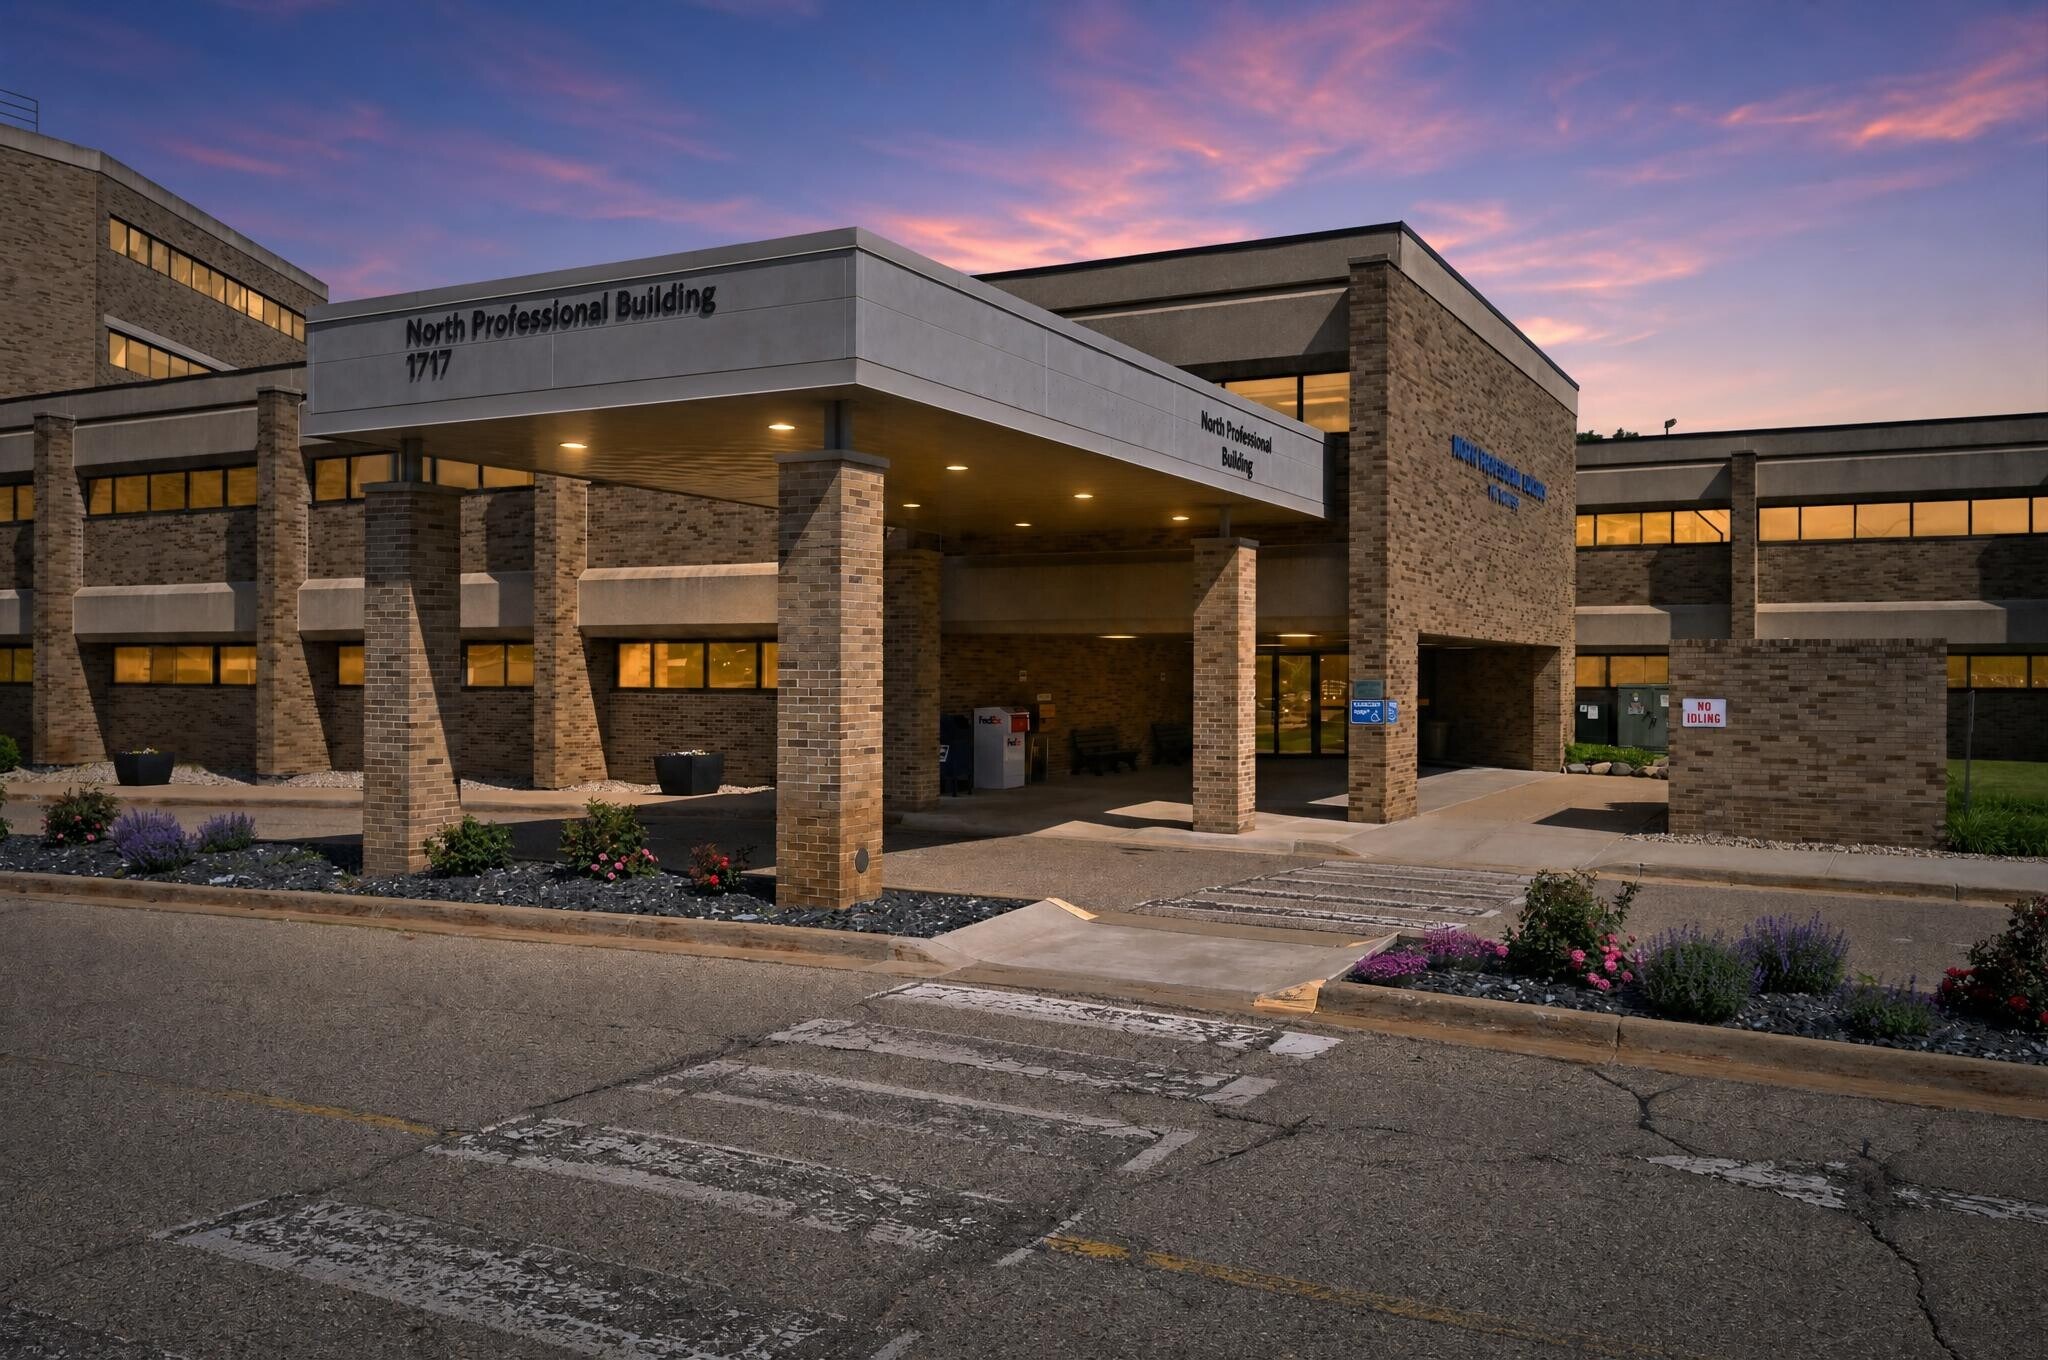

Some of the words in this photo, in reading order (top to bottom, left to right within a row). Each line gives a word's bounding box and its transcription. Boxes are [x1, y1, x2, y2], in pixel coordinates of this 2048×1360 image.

[406, 312, 465, 347] North
[472, 292, 608, 340] Professional
[616, 282, 716, 319] Building
[406, 350, 452, 382] 1717
[1201, 410, 1225, 437] North
[1226, 420, 1272, 454] Professional
[1222, 446, 1253, 480] Building
[979, 715, 1002, 725] FedEx
[1686, 713, 1721, 724] IDLING
[1697, 701, 1712, 711] NO
